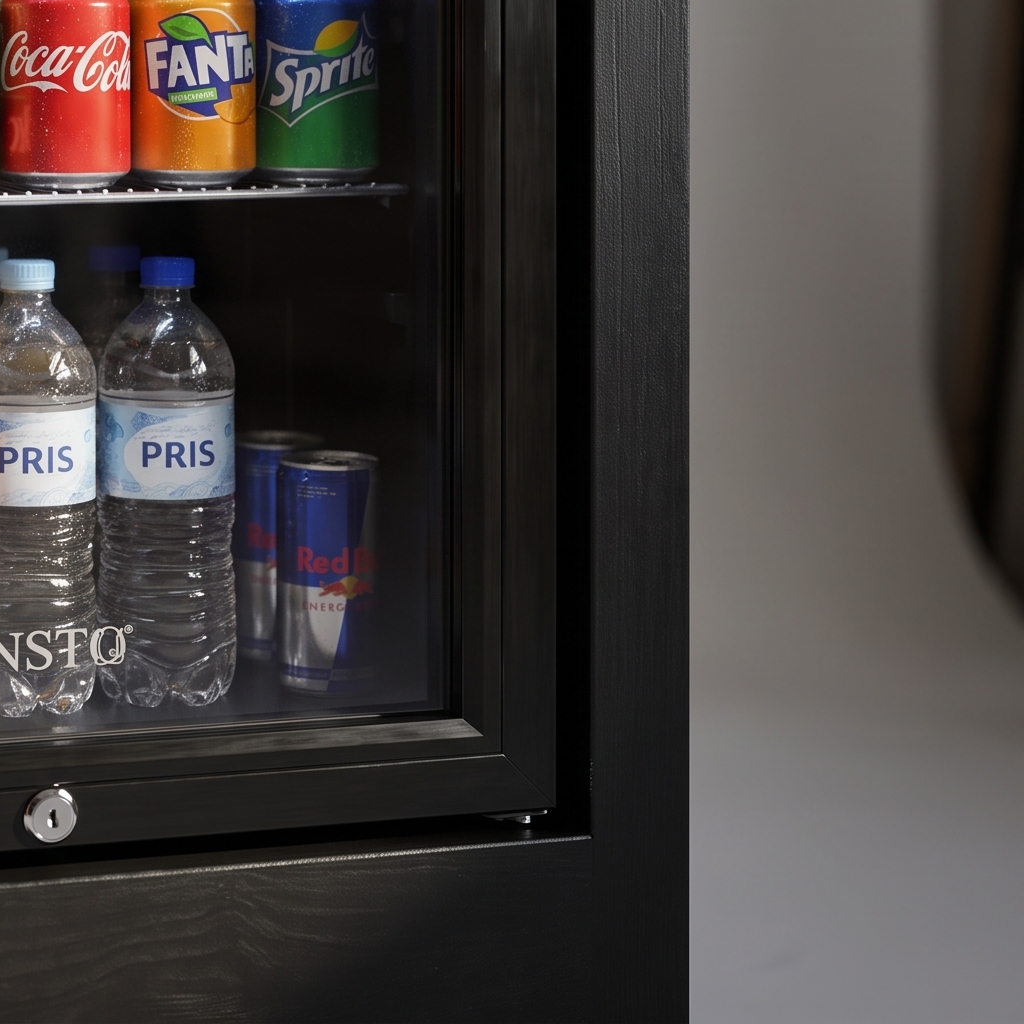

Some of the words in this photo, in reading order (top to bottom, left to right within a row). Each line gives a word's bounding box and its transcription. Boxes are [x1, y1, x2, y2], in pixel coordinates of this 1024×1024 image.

[146, 34, 255, 90] FANTA
[269, 36, 375, 113] Sprite
[141, 439, 215, 468] PRIS
[297, 545, 350, 574] Red
